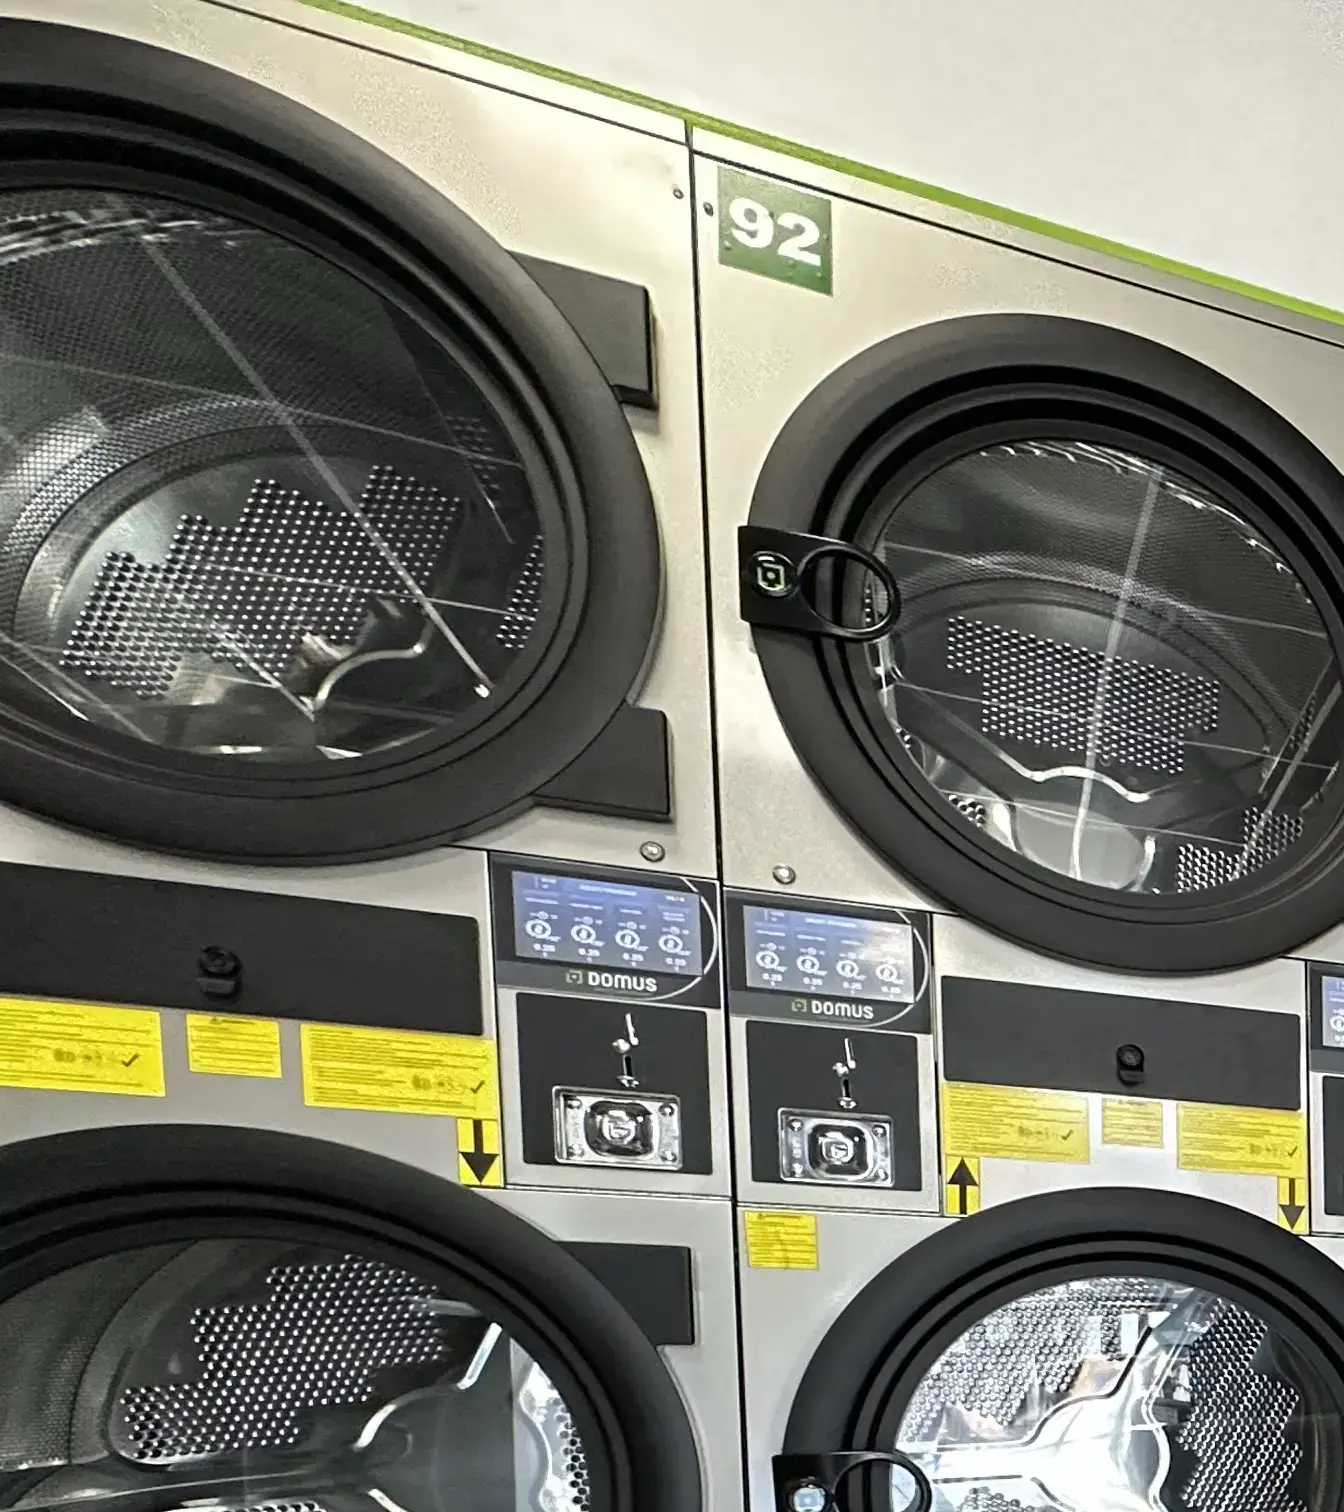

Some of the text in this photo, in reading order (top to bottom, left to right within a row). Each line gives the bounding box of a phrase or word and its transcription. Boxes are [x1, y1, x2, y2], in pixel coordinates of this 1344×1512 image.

[729, 197, 821, 267] 92
[588, 971, 658, 992] DOMUS
[811, 1000, 874, 1019] DOMUS
